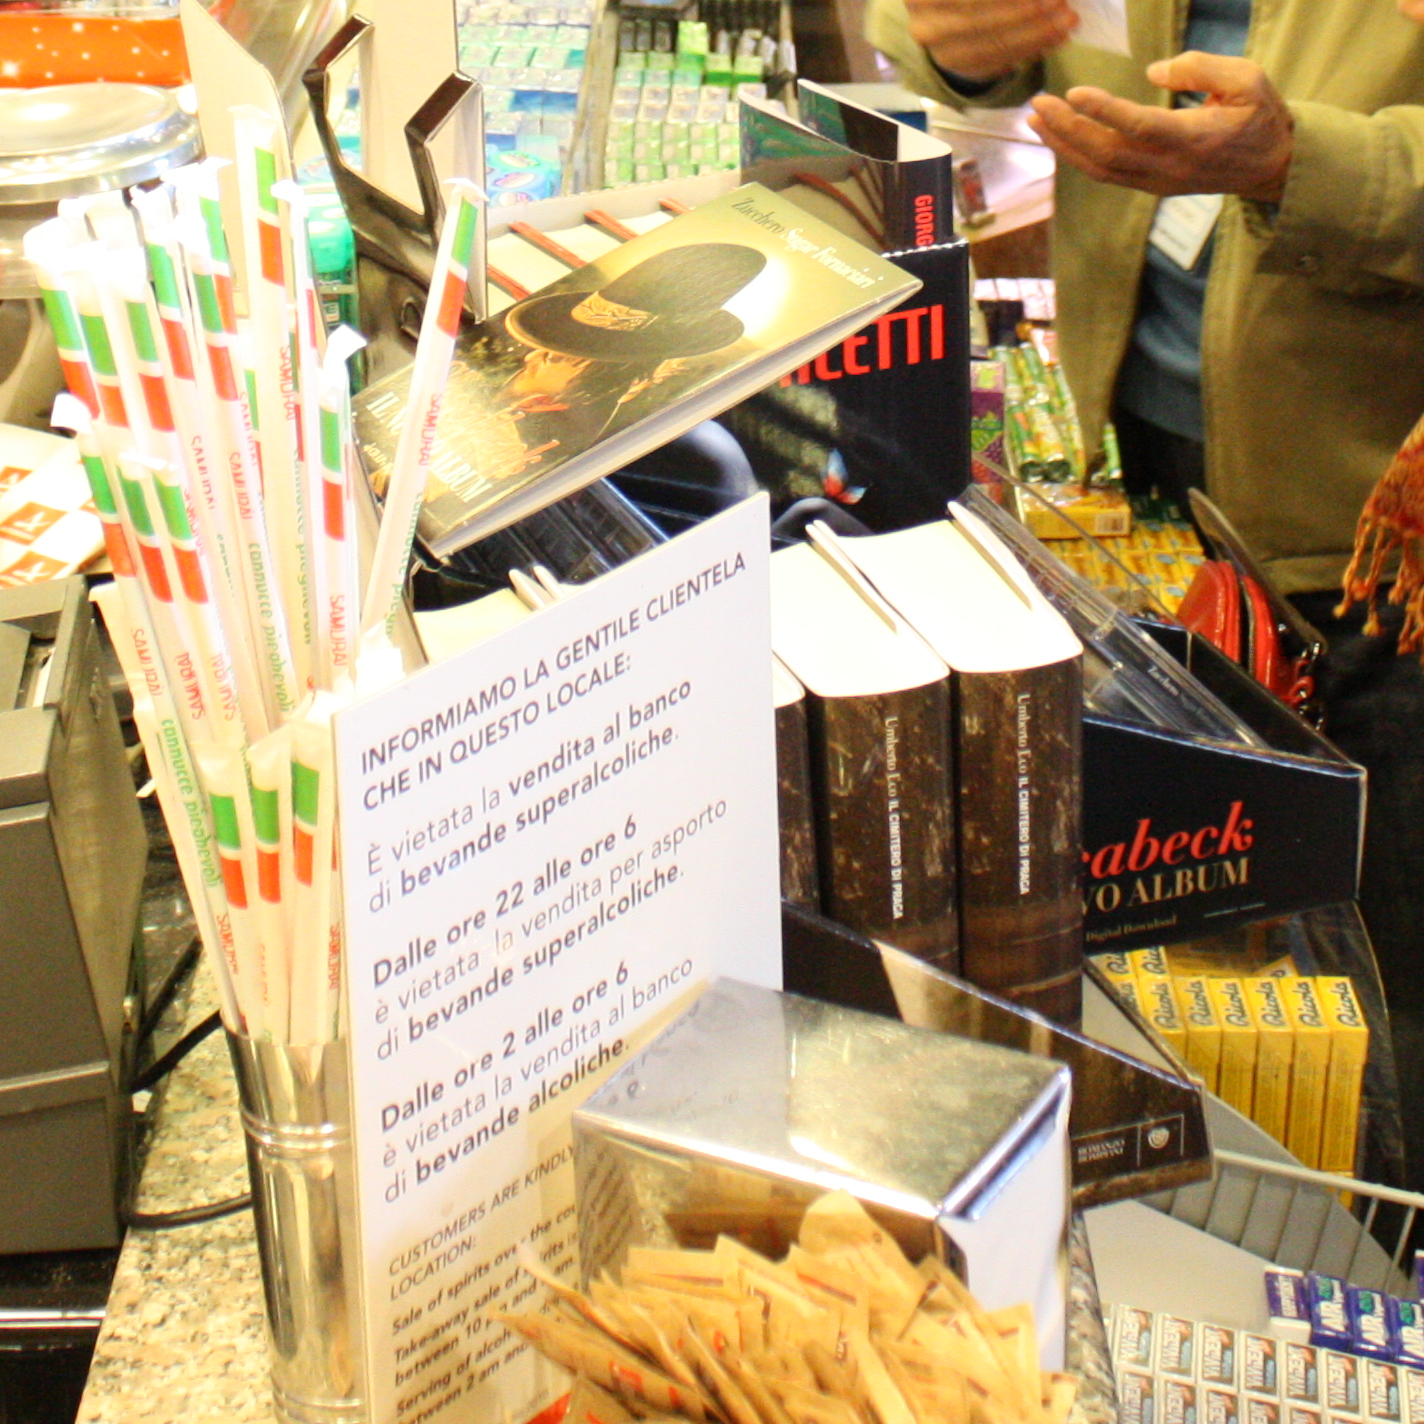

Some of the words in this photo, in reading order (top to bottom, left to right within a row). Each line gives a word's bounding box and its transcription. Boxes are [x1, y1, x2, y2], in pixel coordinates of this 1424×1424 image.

[732, 197, 783, 235] Zucchero
[780, 227, 819, 253] Sugar
[779, 304, 945, 389] LETTI
[420, 393, 444, 466] SAMURAI
[249, 542, 273, 619] cannucce
[263, 626, 294, 713] pieghevoli
[330, 594, 347, 667] SAMURAI
[361, 676, 517, 776] INFORMIAMO
[523, 659, 551, 690] LA
[555, 609, 641, 671] GENTILE
[646, 552, 746, 623] CLIENTELA
[363, 768, 412, 811] CHE
[419, 754, 443, 784] IN
[449, 701, 540, 765] QUESTO
[547, 653, 632, 715] LOCALE:
[885, 716, 900, 770] Umberto
[1017, 694, 1031, 747] Umberto
[367, 843, 382, 875] È
[391, 802, 474, 864] vietata
[481, 785, 501, 813] la
[509, 729, 595, 798] vendita
[602, 712, 621, 745] al
[629, 681, 691, 731] banco
[886, 772, 901, 797] Eco
[1017, 749, 1032, 774] Eco
[1018, 776, 1029, 789] IL
[161, 718, 193, 796] cannucce
[184, 799, 220, 888] pieghevoli
[369, 878, 392, 914] di
[400, 821, 507, 896] bevande
[515, 725, 680, 831] superalcoliche.
[888, 799, 899, 812] IL
[1018, 790, 1030, 842] CIMITERO
[889, 813, 901, 866] CIMITERO
[1019, 844, 1030, 857] DI
[1082, 799, 1255, 880] abeck
[373, 935, 437, 989] Dalle
[446, 907, 487, 947] ore
[495, 881, 524, 920] 22
[532, 857, 572, 895] alle
[580, 832, 616, 866] ore
[623, 814, 637, 840] 6
[891, 868, 902, 881] DI
[892, 882, 904, 920] PRAGA
[1019, 859, 1030, 895] PRAGA
[1128, 856, 1250, 907] ALBUM
[375, 999, 389, 1025] è
[397, 950, 480, 1012] vietata
[494, 928, 514, 956] la
[521, 877, 603, 941] vendita
[610, 851, 644, 895] per
[650, 798, 727, 860] asporto
[377, 1025, 399, 1062] di
[408, 966, 514, 1042] bevande
[522, 864, 684, 974] superalcoliche.
[1154, 981, 1177, 1029] Ricola
[1189, 980, 1211, 1027] Ricola
[1226, 981, 1250, 1028] Ricola
[1261, 980, 1284, 1027] Ricola
[1297, 980, 1323, 1029] Ricola
[381, 1081, 444, 1133] Dalle
[453, 1053, 493, 1088] ore
[501, 1032, 517, 1059] 2
[523, 1009, 563, 1046] alle
[572, 981, 609, 1014] ore
[615, 961, 630, 985] 6
[383, 1143, 397, 1169] è
[405, 1088, 486, 1154] vietata
[494, 1074, 513, 1101] la
[520, 1017, 601, 1080] vendita
[608, 994, 626, 1027] al
[632, 958, 694, 1012] banco
[384, 1169, 407, 1204] di
[416, 1104, 520, 1186] bevande
[528, 1036, 630, 1113] alcoliche.
[389, 1201, 486, 1277] CUSTOMERS
[490, 1181, 520, 1212] ARE
[524, 1145, 575, 1189] KINDLY
[390, 1235, 476, 1302] LOCATION:
[392, 1307, 422, 1337] Sale
[427, 1292, 443, 1313] of
[447, 1261, 491, 1300] spirits
[530, 1219, 552, 1243] the
[394, 1308, 470, 1365] Take-away
[475, 1285, 501, 1311] sale
[505, 1267, 521, 1289] of
[394, 1336, 459, 1388] between
[465, 1317, 482, 1339] 10
[511, 1279, 537, 1308] and
[1317, 1301, 1346, 1332] AIR
[1359, 1314, 1388, 1346] AIR
[396, 1369, 451, 1418] Serving
[456, 1353, 470, 1375] of
[466, 1374, 475, 1392] 2
[479, 1359, 500, 1383] am
